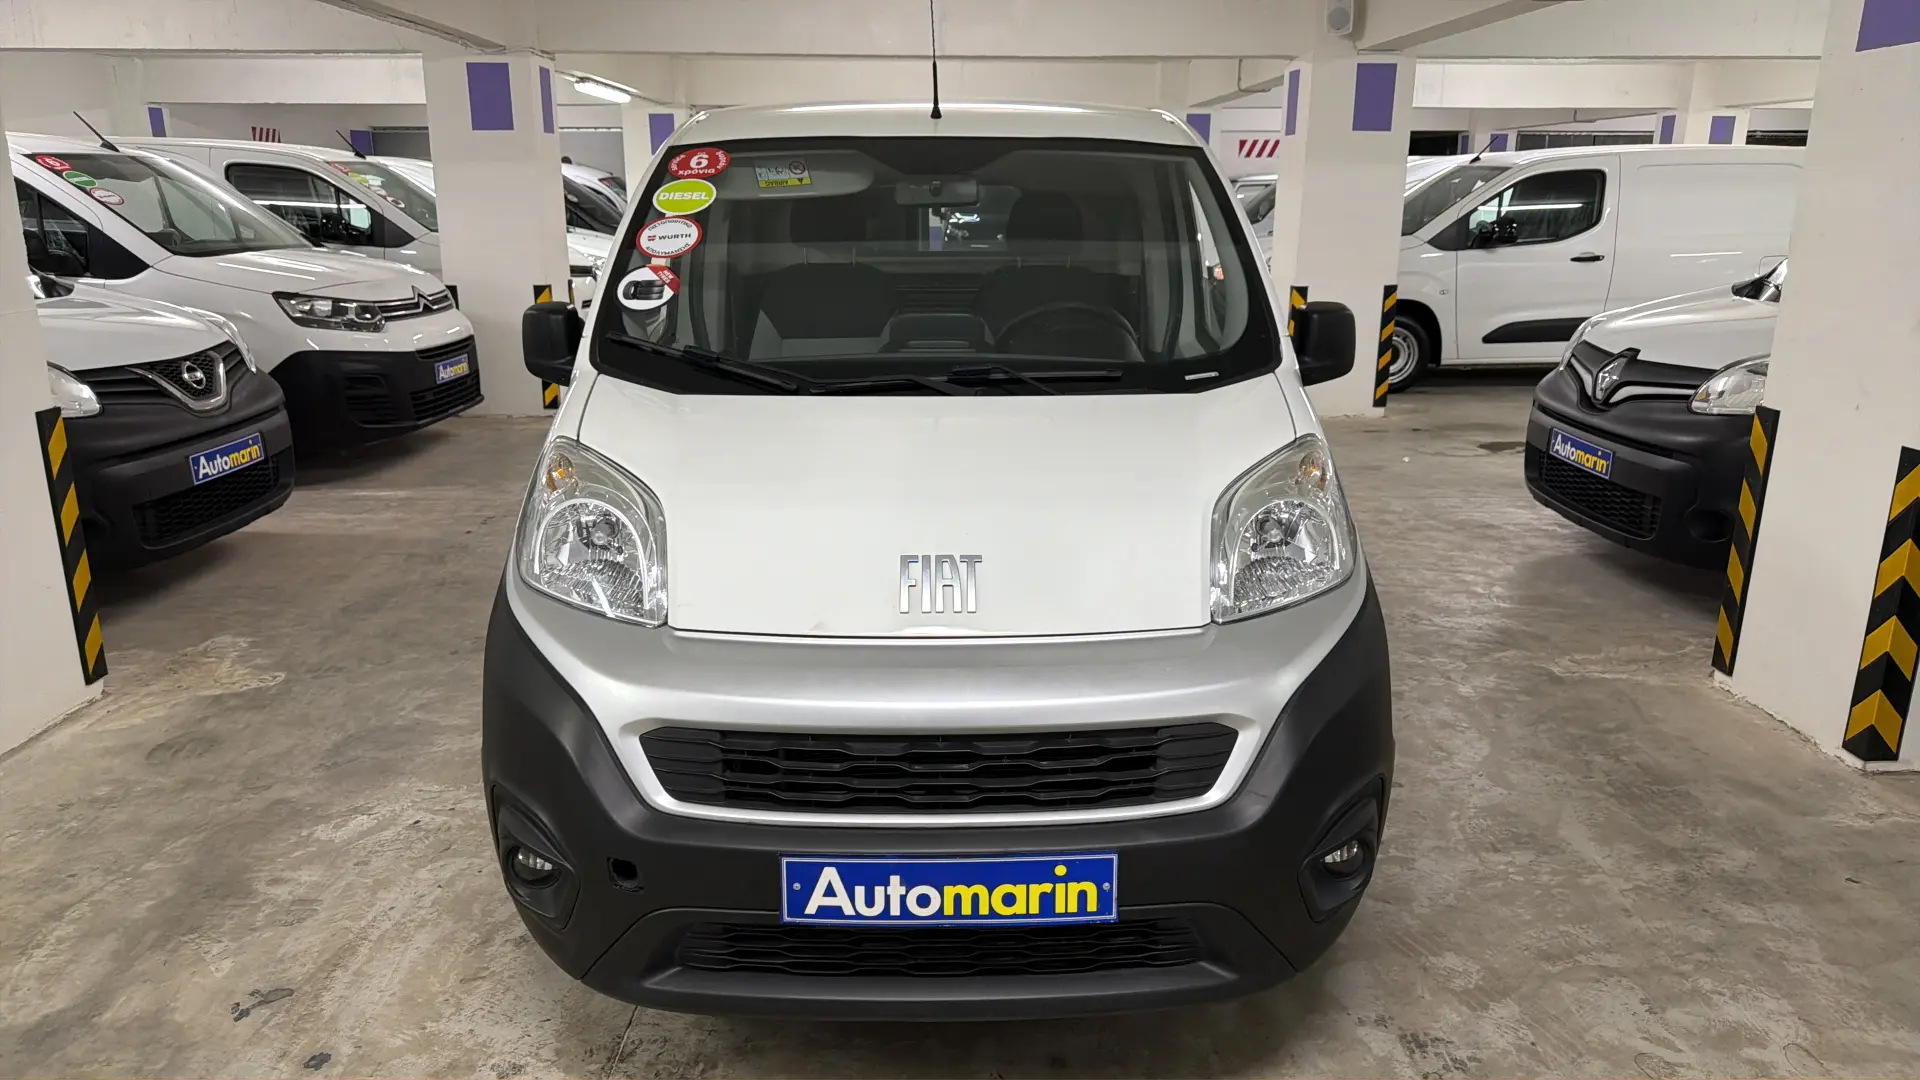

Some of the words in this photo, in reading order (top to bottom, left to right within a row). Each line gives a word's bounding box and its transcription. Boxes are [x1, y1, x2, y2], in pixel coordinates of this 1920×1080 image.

[678, 168, 715, 176] χρόνια
[690, 154, 709, 169] 6
[659, 192, 709, 201] DIESEL
[198, 439, 260, 479] Automarin
[1553, 433, 1607, 474] Automarin
[899, 554, 983, 614] FIAT
[804, 864, 1098, 916] Automarin
